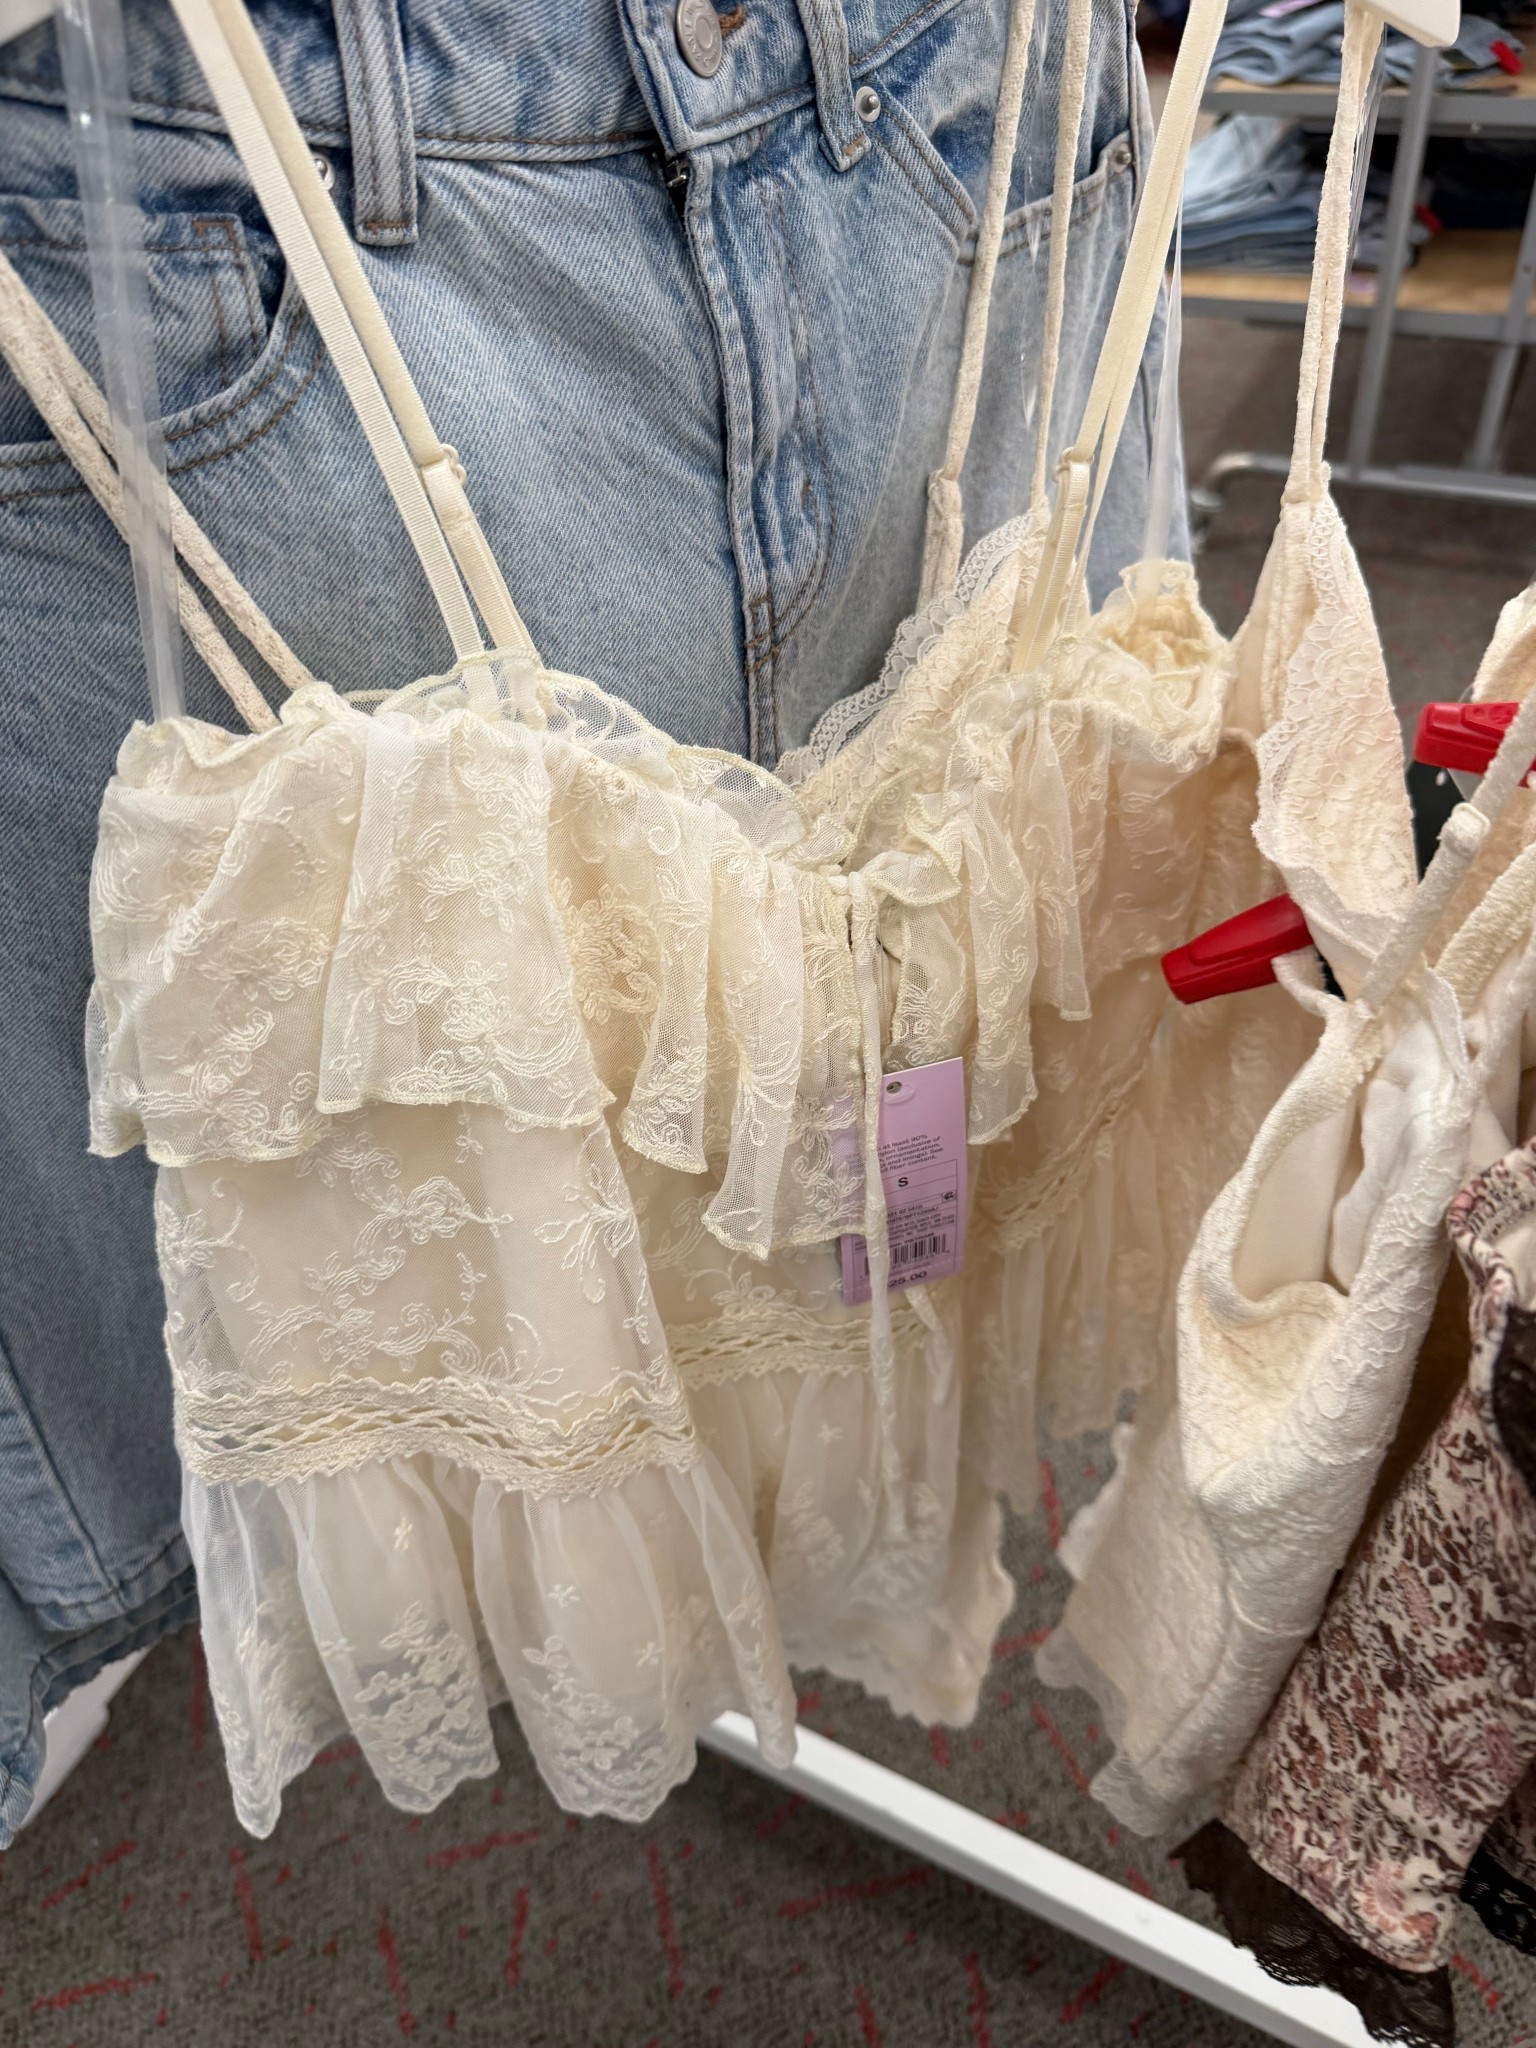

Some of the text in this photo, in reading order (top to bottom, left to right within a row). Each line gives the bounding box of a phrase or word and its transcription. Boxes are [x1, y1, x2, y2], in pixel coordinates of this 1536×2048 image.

[892, 1139, 909, 1147] least
[911, 1134, 928, 1142] 90%
[897, 1139, 931, 1152] (exclusive
[887, 1158, 901, 1166] and
[889, 1163, 907, 1171] fiber
[908, 1155, 936, 1166] content.
[898, 1176, 909, 1187] S
[887, 1271, 927, 1288] 25.00
